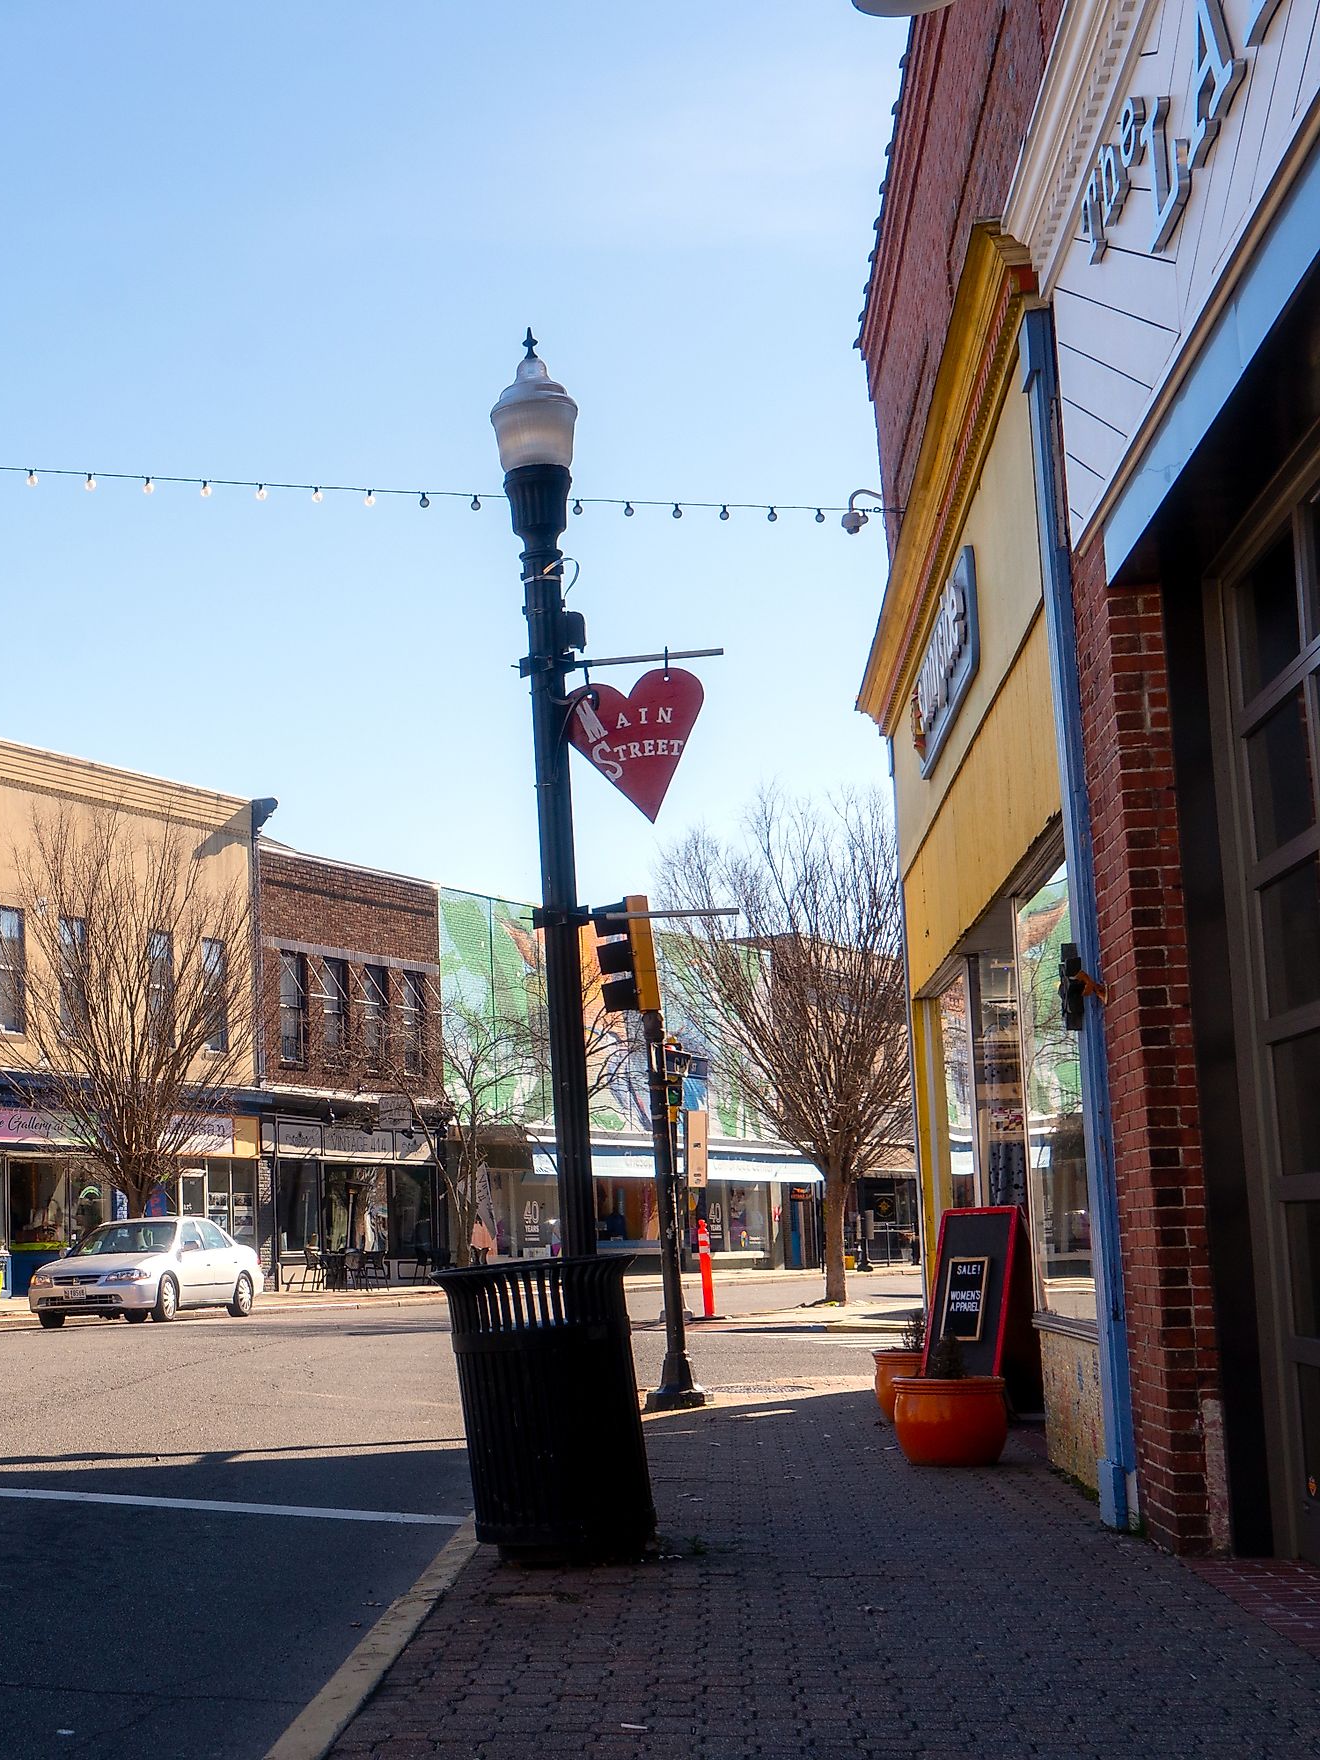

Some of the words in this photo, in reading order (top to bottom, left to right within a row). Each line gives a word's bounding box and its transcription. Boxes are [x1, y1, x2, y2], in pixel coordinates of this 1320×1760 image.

[1082, 95, 1146, 265] The
[576, 700, 673, 743] MAIN
[592, 739, 684, 782] STREET
[7, 1113, 52, 1138] Gallery
[330, 1134, 368, 1152] VINTAGE
[370, 1136, 387, 1153] 414
[523, 1200, 540, 1225] 40
[708, 1202, 722, 1224] 40
[524, 1224, 540, 1233] YEARS
[956, 1264, 981, 1275] SALE!
[949, 1301, 980, 1312] APPAREL
[950, 1290, 981, 1301] WOMEN'S
